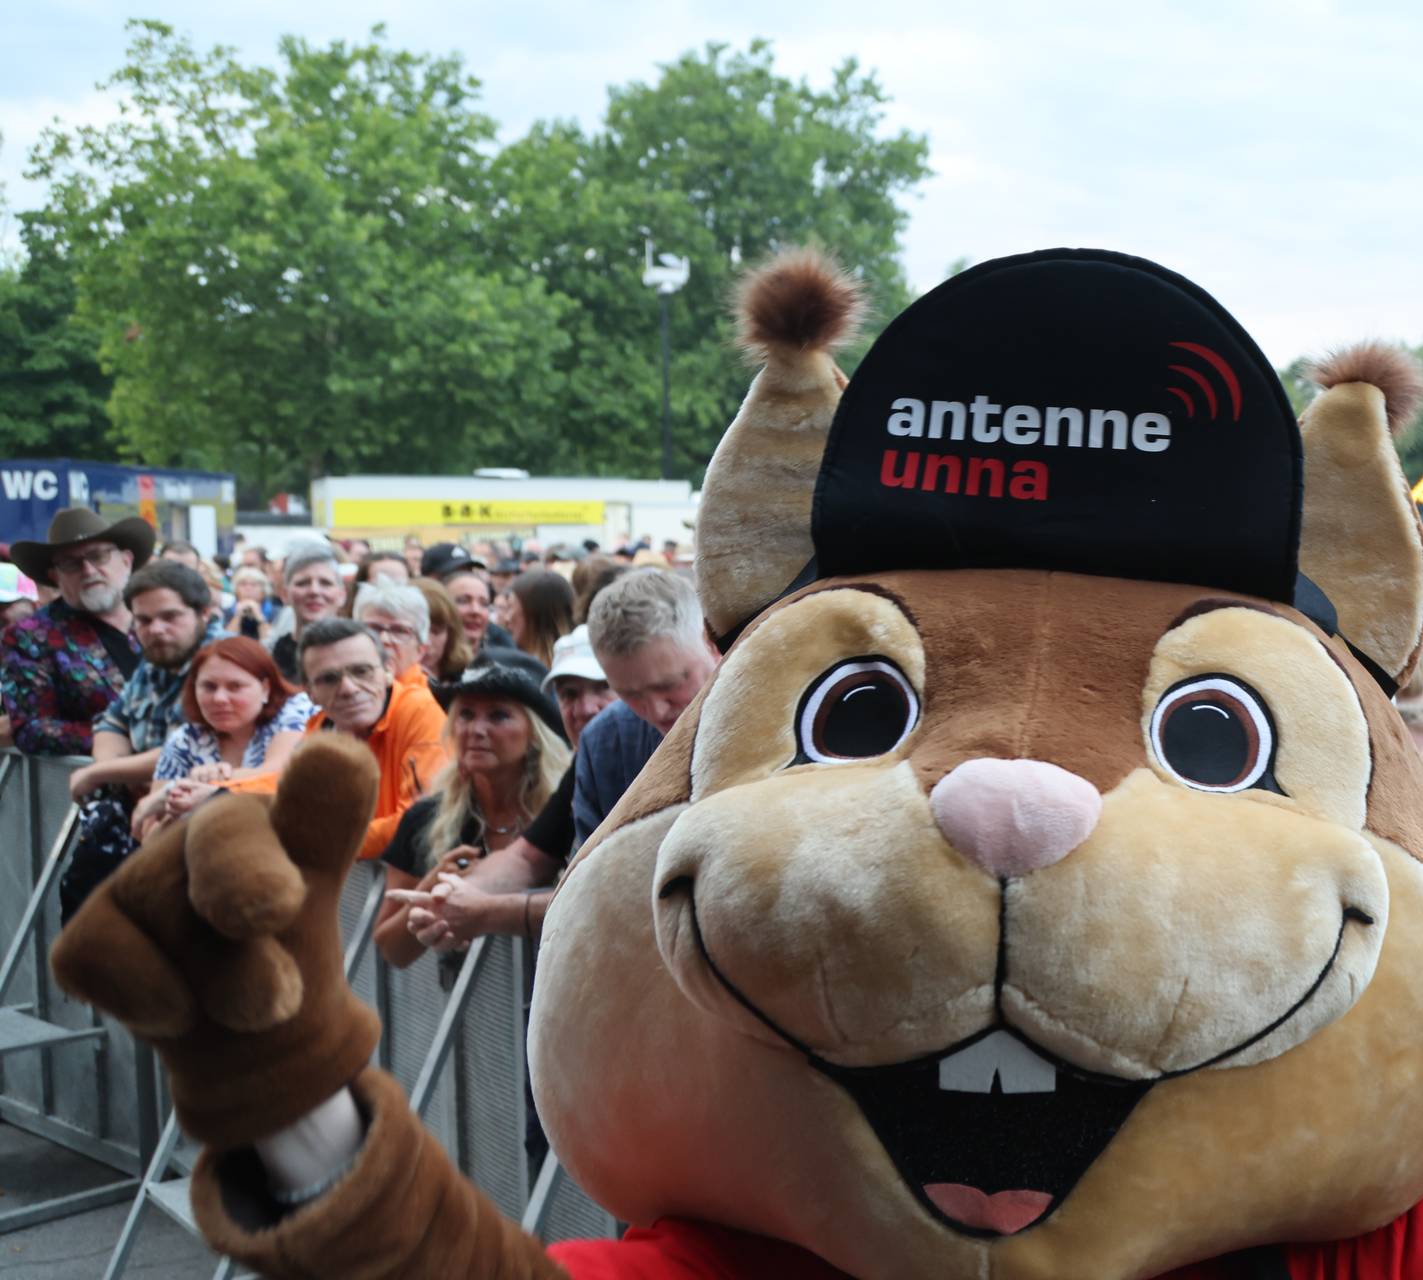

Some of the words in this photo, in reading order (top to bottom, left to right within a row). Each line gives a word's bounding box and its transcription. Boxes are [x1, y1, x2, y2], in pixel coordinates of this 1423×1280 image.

[887, 395, 1172, 452] antenne
[1, 470, 58, 500] WC
[880, 449, 1049, 501] unna
